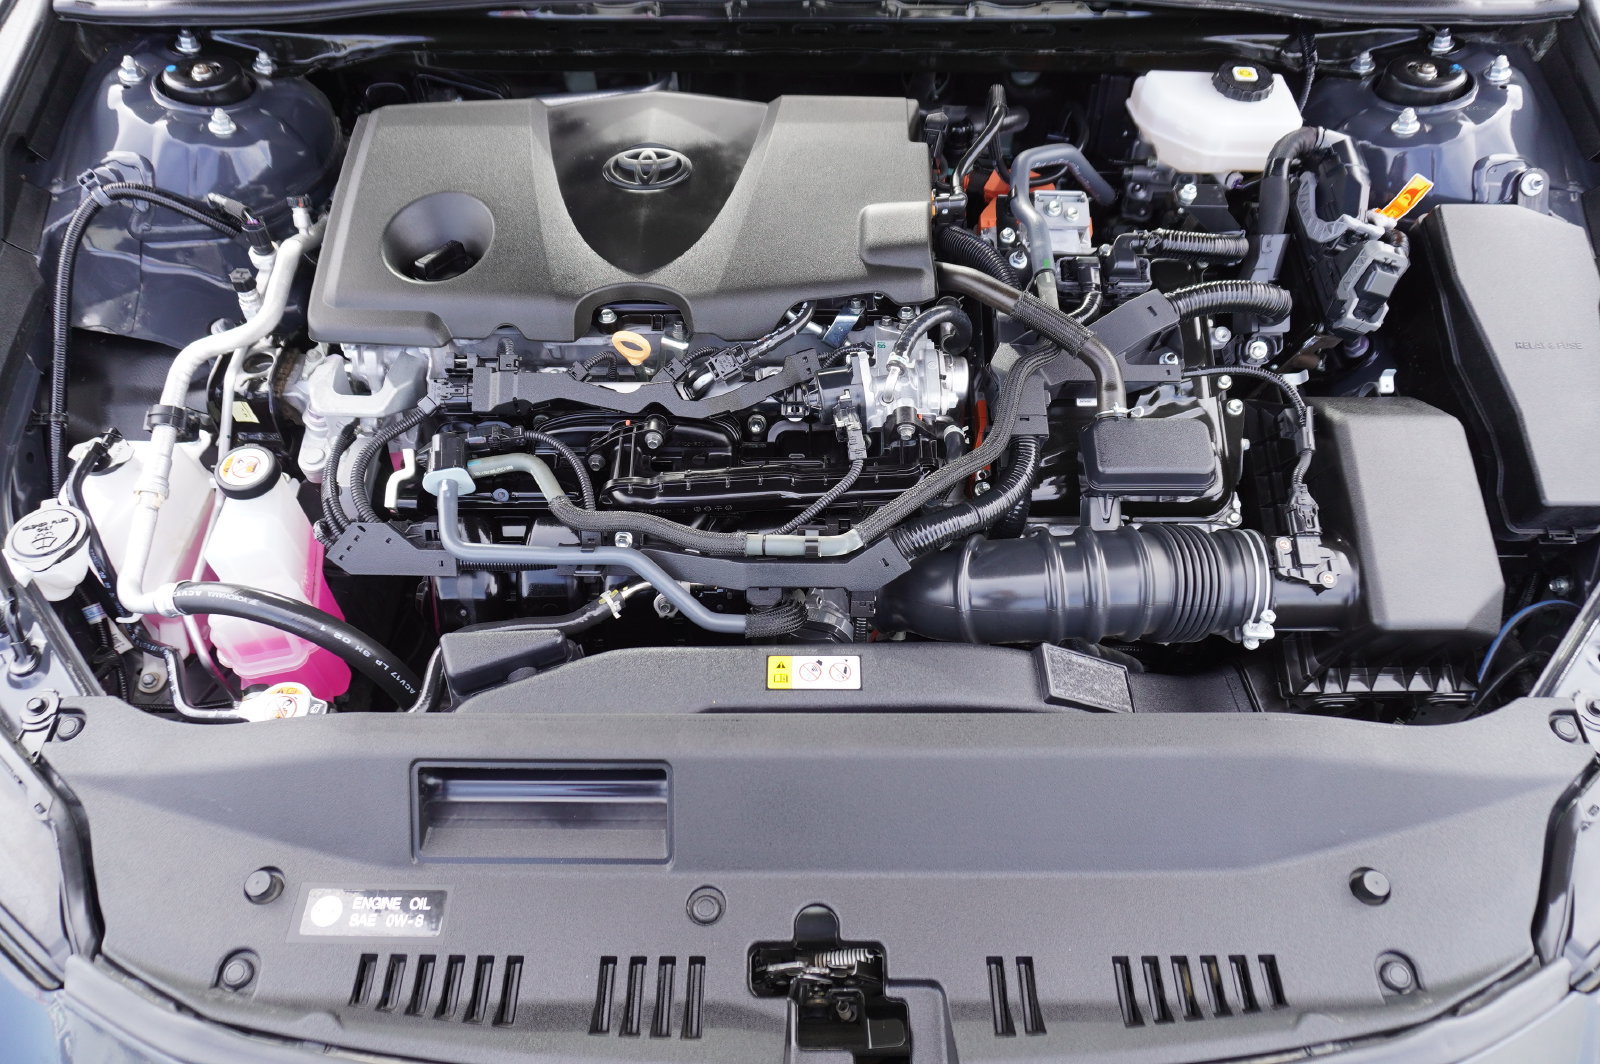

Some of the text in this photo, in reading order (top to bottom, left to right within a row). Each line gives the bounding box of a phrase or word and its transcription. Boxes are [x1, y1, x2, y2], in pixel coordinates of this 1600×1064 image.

[1557, 342, 1583, 350] FUSE
[375, 659, 390, 671] LP
[390, 671, 416, 694] ACV17
[352, 896, 431, 911] ENGINE OIL
